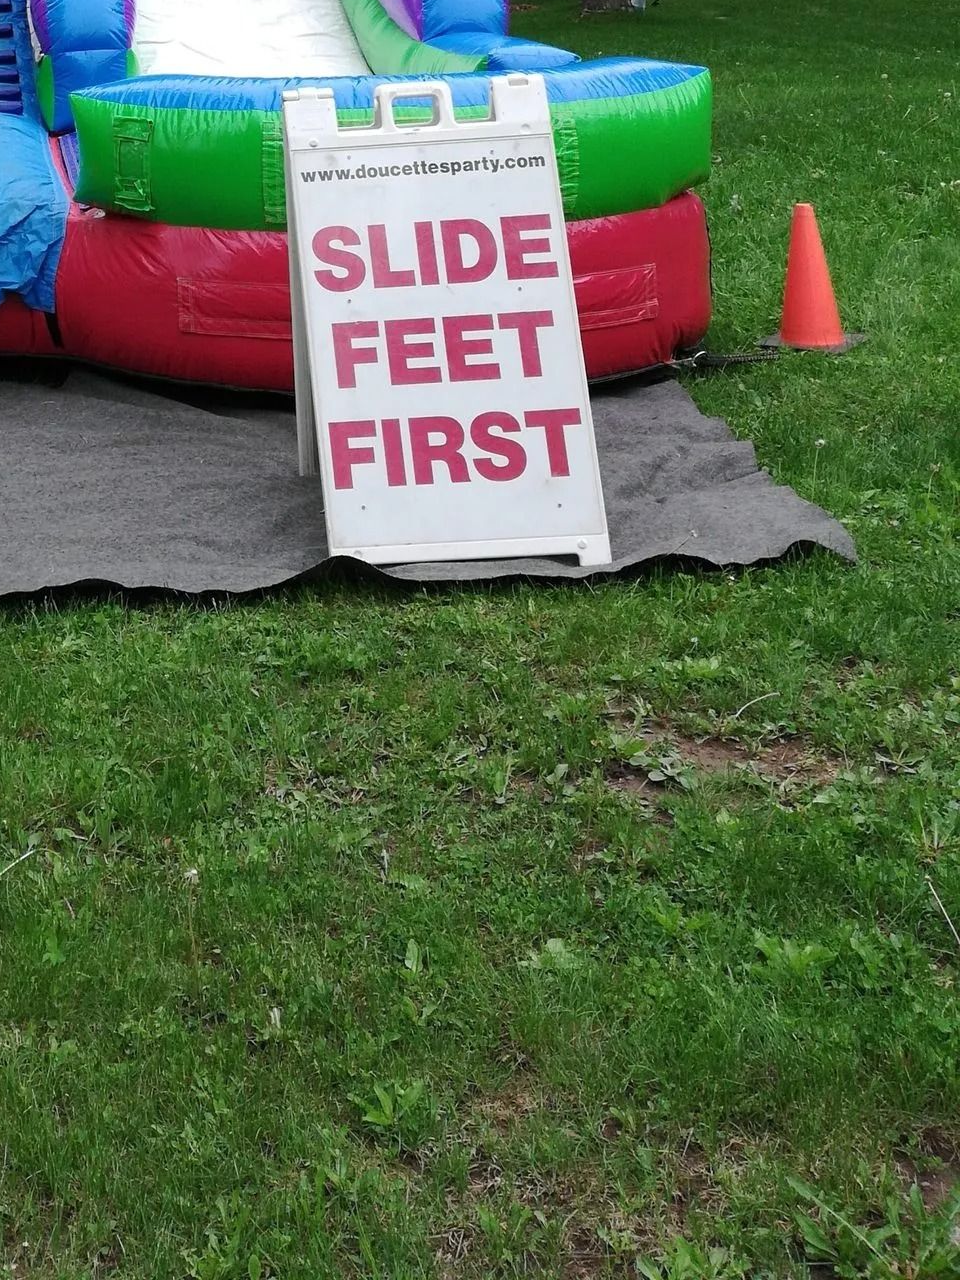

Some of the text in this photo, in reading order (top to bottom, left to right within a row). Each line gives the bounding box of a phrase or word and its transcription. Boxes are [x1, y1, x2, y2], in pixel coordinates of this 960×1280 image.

[301, 154, 546, 183] www.doucettesparty.com
[311, 213, 559, 292] SLIDE
[331, 310, 554, 389] FEET
[328, 407, 581, 490] FIRST
